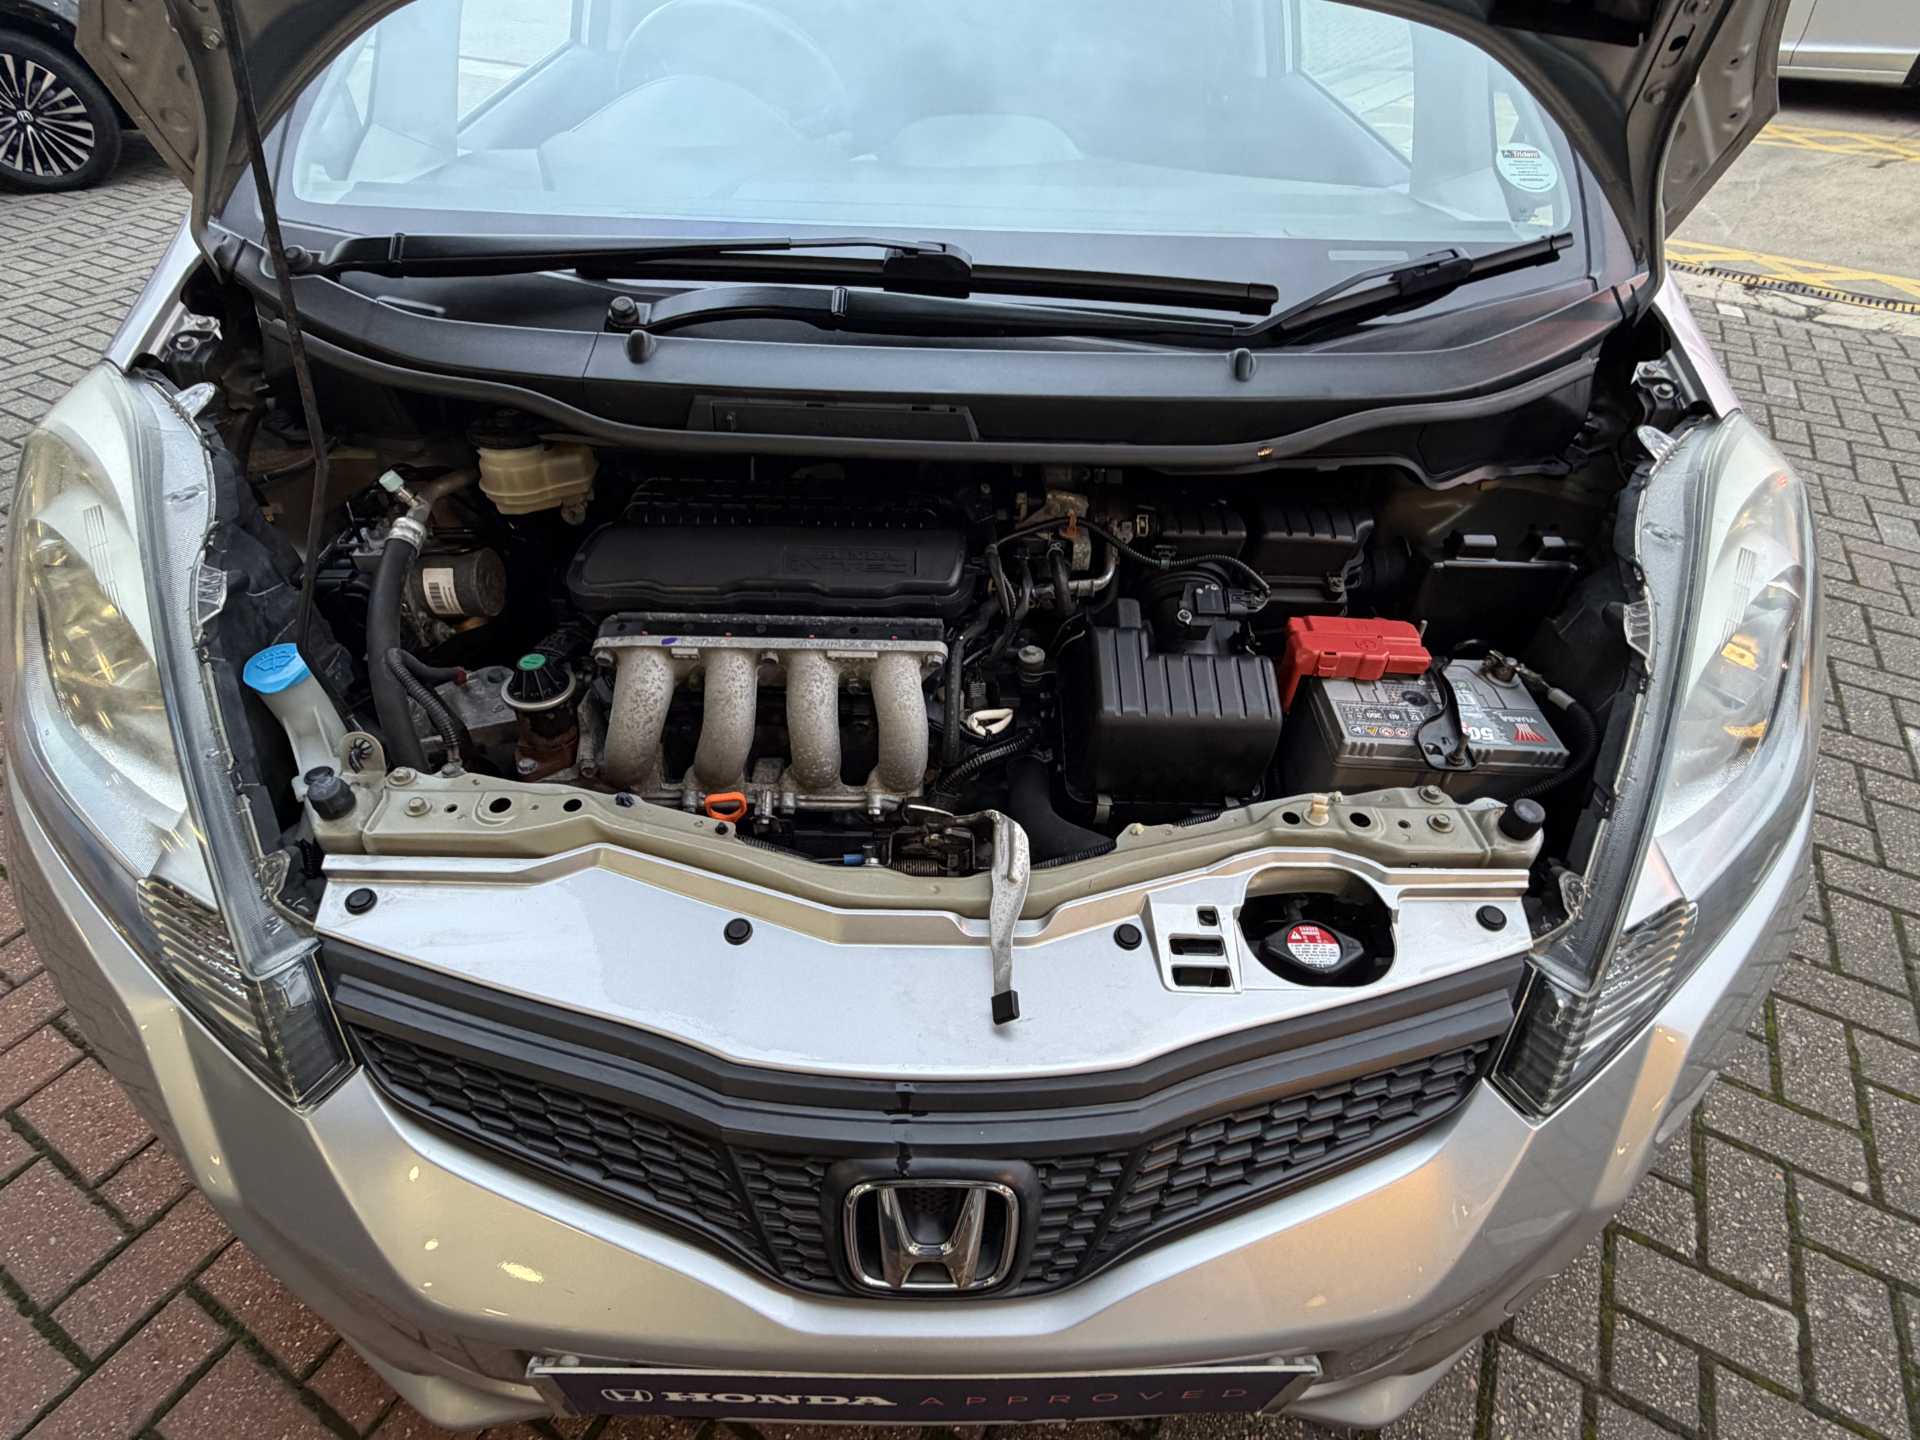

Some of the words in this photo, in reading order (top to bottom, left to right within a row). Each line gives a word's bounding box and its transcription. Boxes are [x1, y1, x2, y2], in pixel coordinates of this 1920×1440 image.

[1499, 715, 1538, 724] YUASA
[661, 1392, 898, 1407] HONDA
[919, 1388, 1248, 1406] APPROVED
